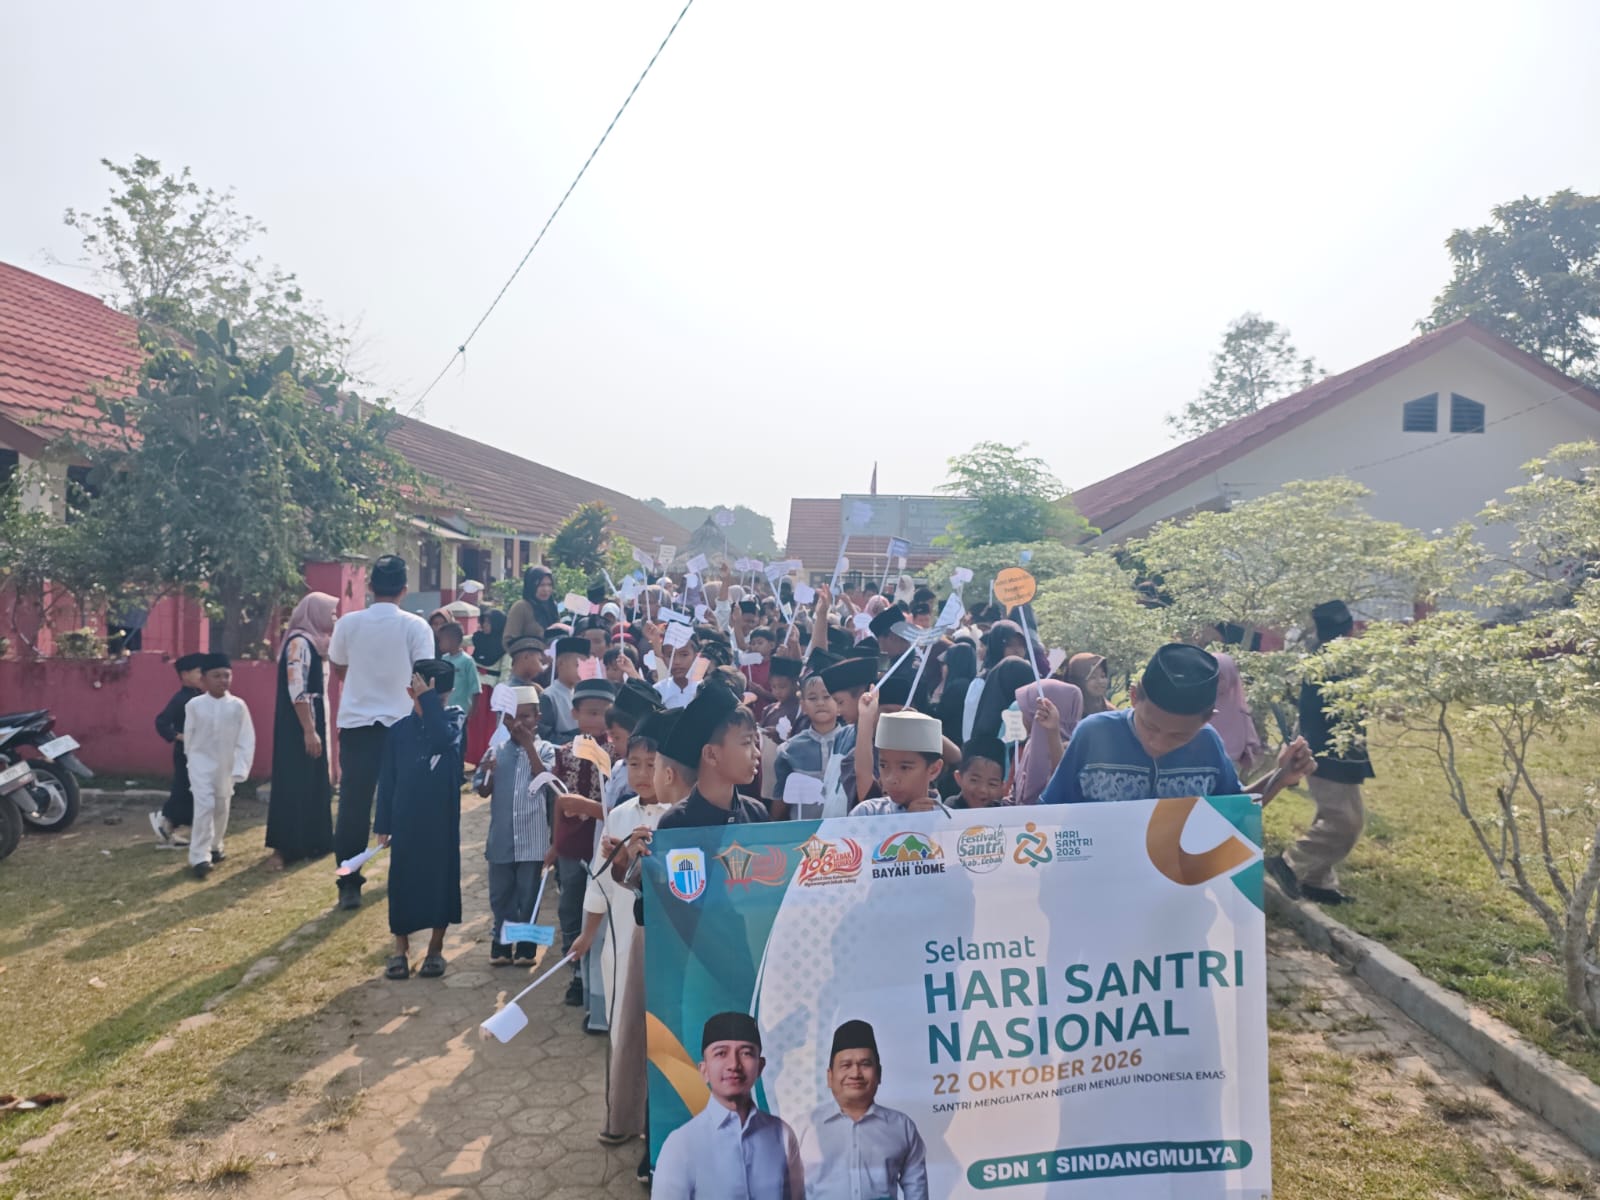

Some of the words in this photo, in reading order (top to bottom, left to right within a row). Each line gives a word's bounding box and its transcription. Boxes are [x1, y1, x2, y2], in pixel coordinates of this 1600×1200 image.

[1054, 831, 1079, 839] HARI
[1055, 838, 1093, 848] SANTRI
[1056, 847, 1081, 857] 2026
[872, 866, 910, 878] BAYAH
[914, 863, 945, 875] DOME
[925, 935, 1036, 964] Selamat
[924, 966, 1048, 1014] HARI
[1064, 950, 1244, 1004] SANTRI
[928, 1000, 1190, 1065] NASIONAL
[932, 1073, 961, 1096] 22
[968, 1059, 1085, 1092] OKTOBER
[1091, 1048, 1143, 1074] 2026
[932, 1102, 972, 1113] SANTRI
[974, 1090, 1049, 1109] MENGUATKAN
[1051, 1083, 1087, 1098] NEGERI
[1089, 1075, 1131, 1091] MENUJU
[1133, 1071, 1193, 1084] INDONESIA
[1196, 1070, 1226, 1081] EMAS
[982, 1160, 1029, 1182] SDN
[1036, 1158, 1048, 1176] 1
[1056, 1146, 1238, 1175] SINDANGMULYA
